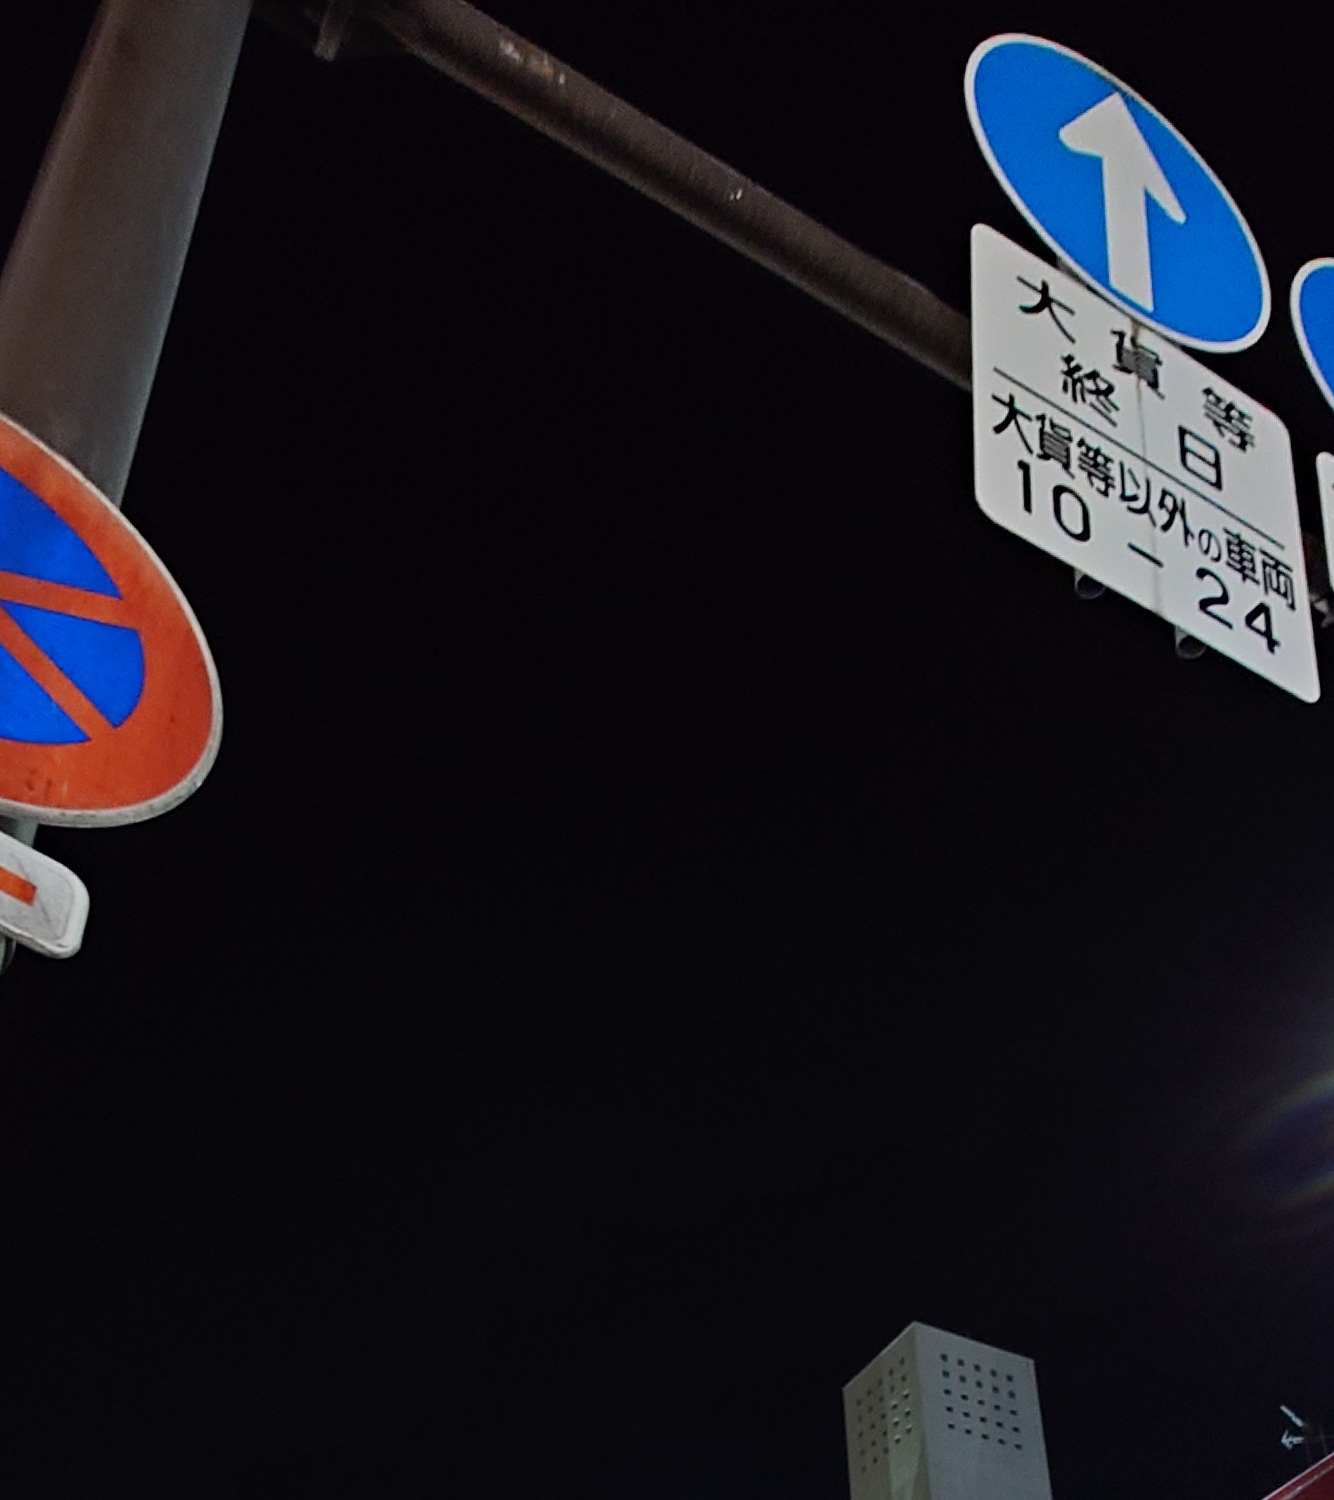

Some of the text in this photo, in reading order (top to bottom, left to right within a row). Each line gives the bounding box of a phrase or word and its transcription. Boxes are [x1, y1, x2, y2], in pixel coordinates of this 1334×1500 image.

[1017, 275, 1257, 452] 大貨等
[1060, 353, 1224, 493] 終日
[990, 391, 1298, 612] 大貨等以外の車両
